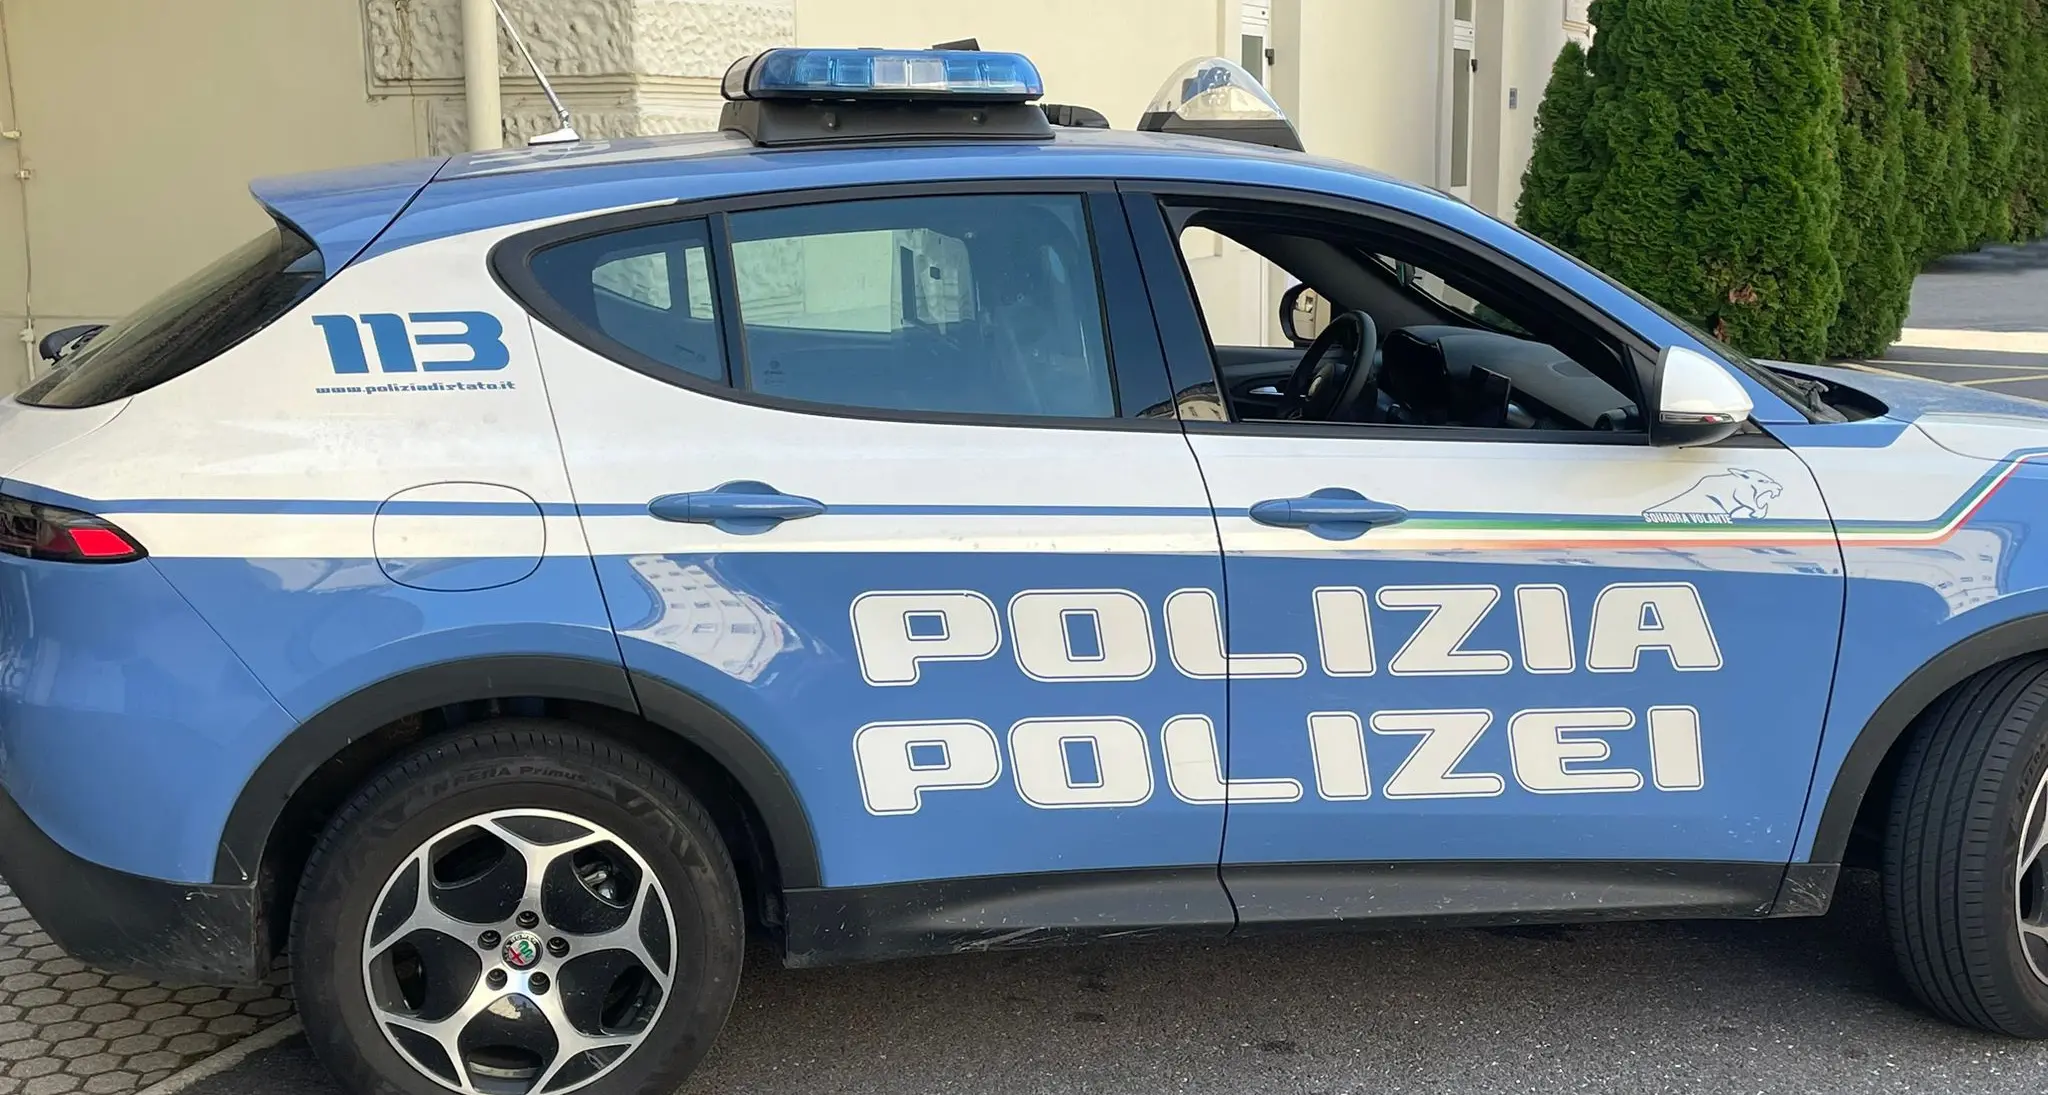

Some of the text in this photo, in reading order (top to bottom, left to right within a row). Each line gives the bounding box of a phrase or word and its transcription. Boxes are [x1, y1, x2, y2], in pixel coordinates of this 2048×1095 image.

[311, 311, 510, 374] 113
[315, 380, 517, 395] www.poliziadistato.it
[1644, 512, 1733, 524] SQUADRA VOLANTE
[849, 582, 1724, 686] POLIZIA
[519, 765, 588, 784] Primus
[852, 705, 1704, 816] POLIZEI
